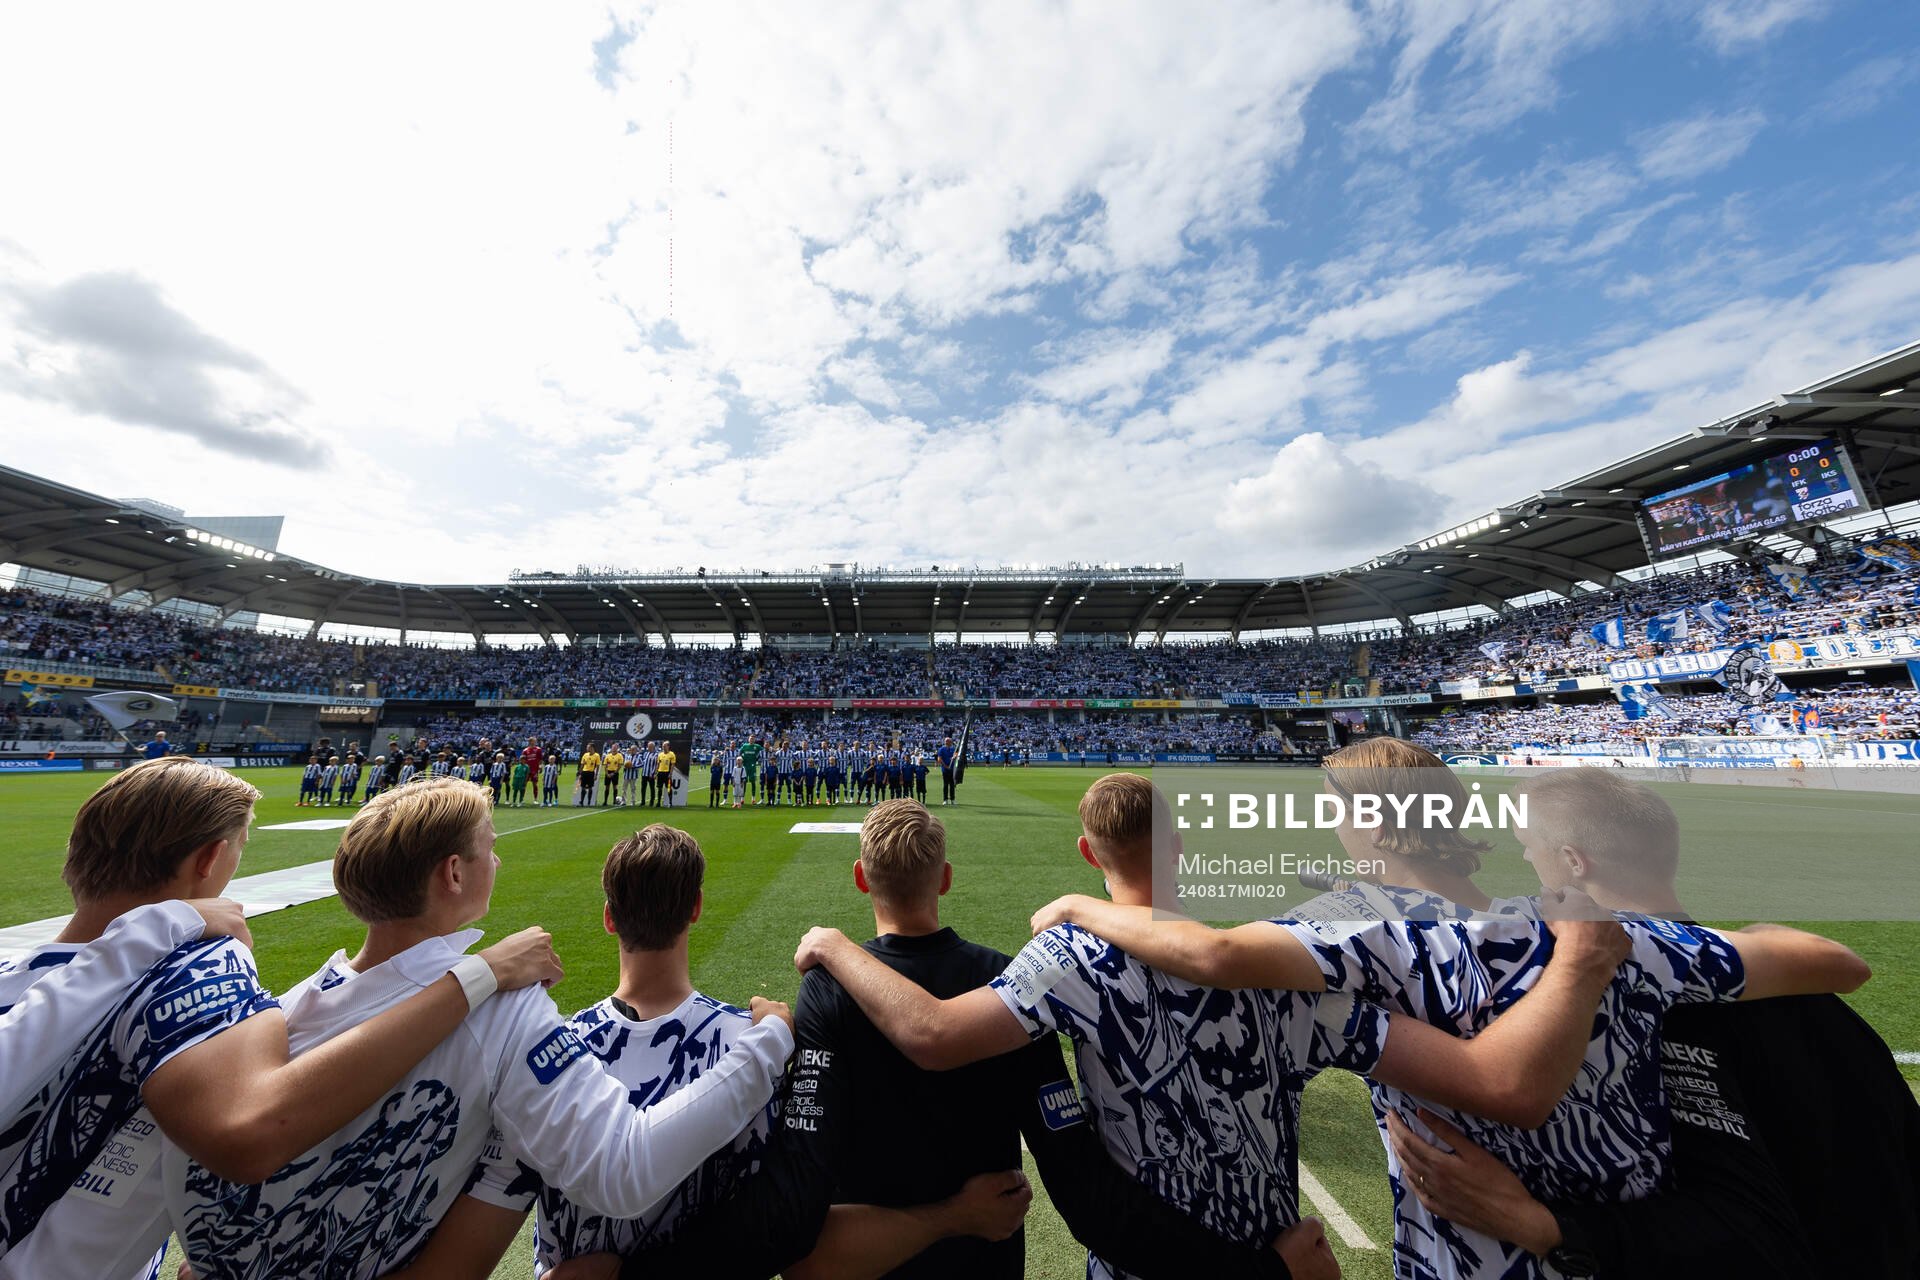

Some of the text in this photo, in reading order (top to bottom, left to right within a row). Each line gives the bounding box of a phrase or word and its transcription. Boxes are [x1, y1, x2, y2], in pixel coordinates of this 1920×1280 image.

[1788, 447, 1820, 463] 0:00
[1819, 457, 1830, 468] 0
[1790, 467, 1800, 477] 0
[1791, 478, 1807, 488] IFK
[1798, 497, 1832, 511] forza
[1801, 499, 1853, 519] football
[1732, 521, 1763, 534] TOMMA
[1763, 515, 1787, 526] GLAS
[1384, 695, 1429, 705] merinfo.se
[658, 722, 688, 730] UNIBET
[241, 757, 284, 767] BRIXLY
[1178, 754, 1211, 762] GÖTEBORG
[154, 979, 247, 1022] UNIBET
[1670, 1108, 1751, 1140] MOBILL
